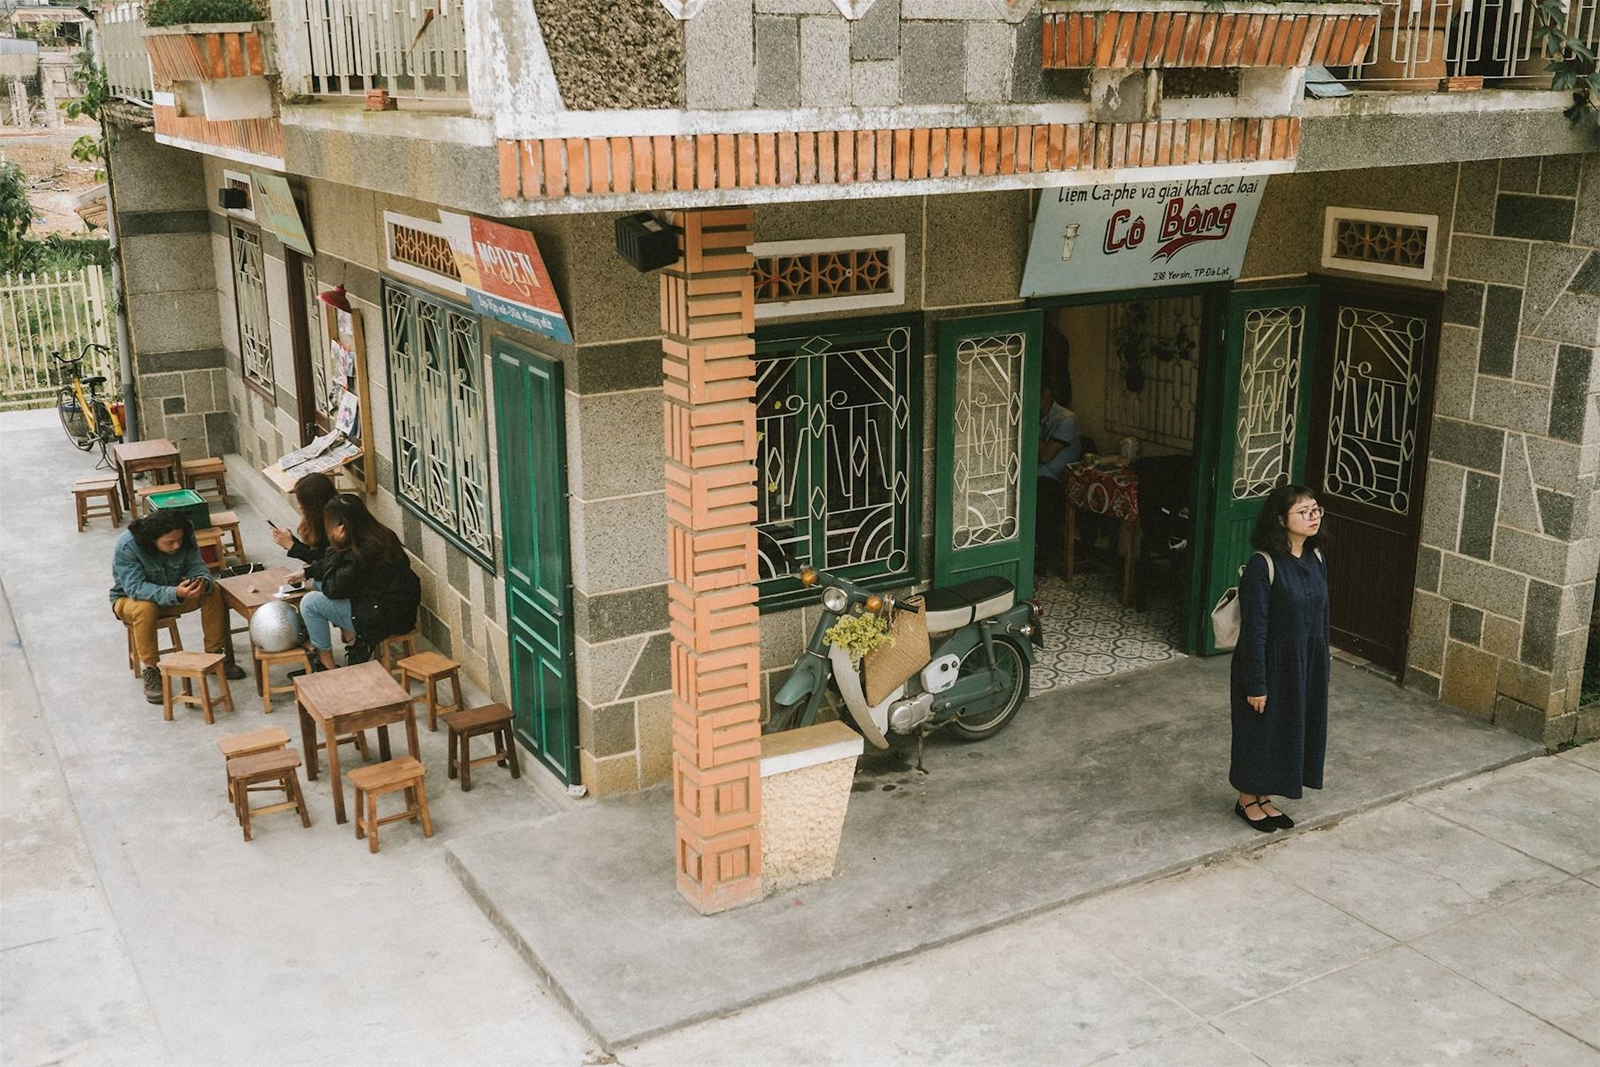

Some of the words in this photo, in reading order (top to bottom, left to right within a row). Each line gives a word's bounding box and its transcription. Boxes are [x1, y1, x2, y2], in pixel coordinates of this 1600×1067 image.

[1141, 183, 1156, 199] và
[1184, 179, 1213, 197] khát
[1213, 179, 1235, 195] các
[1236, 176, 1259, 196] loại
[1103, 208, 1146, 255] Cô
[1156, 197, 1237, 250] Bông
[1152, 271, 1166, 281] 238
